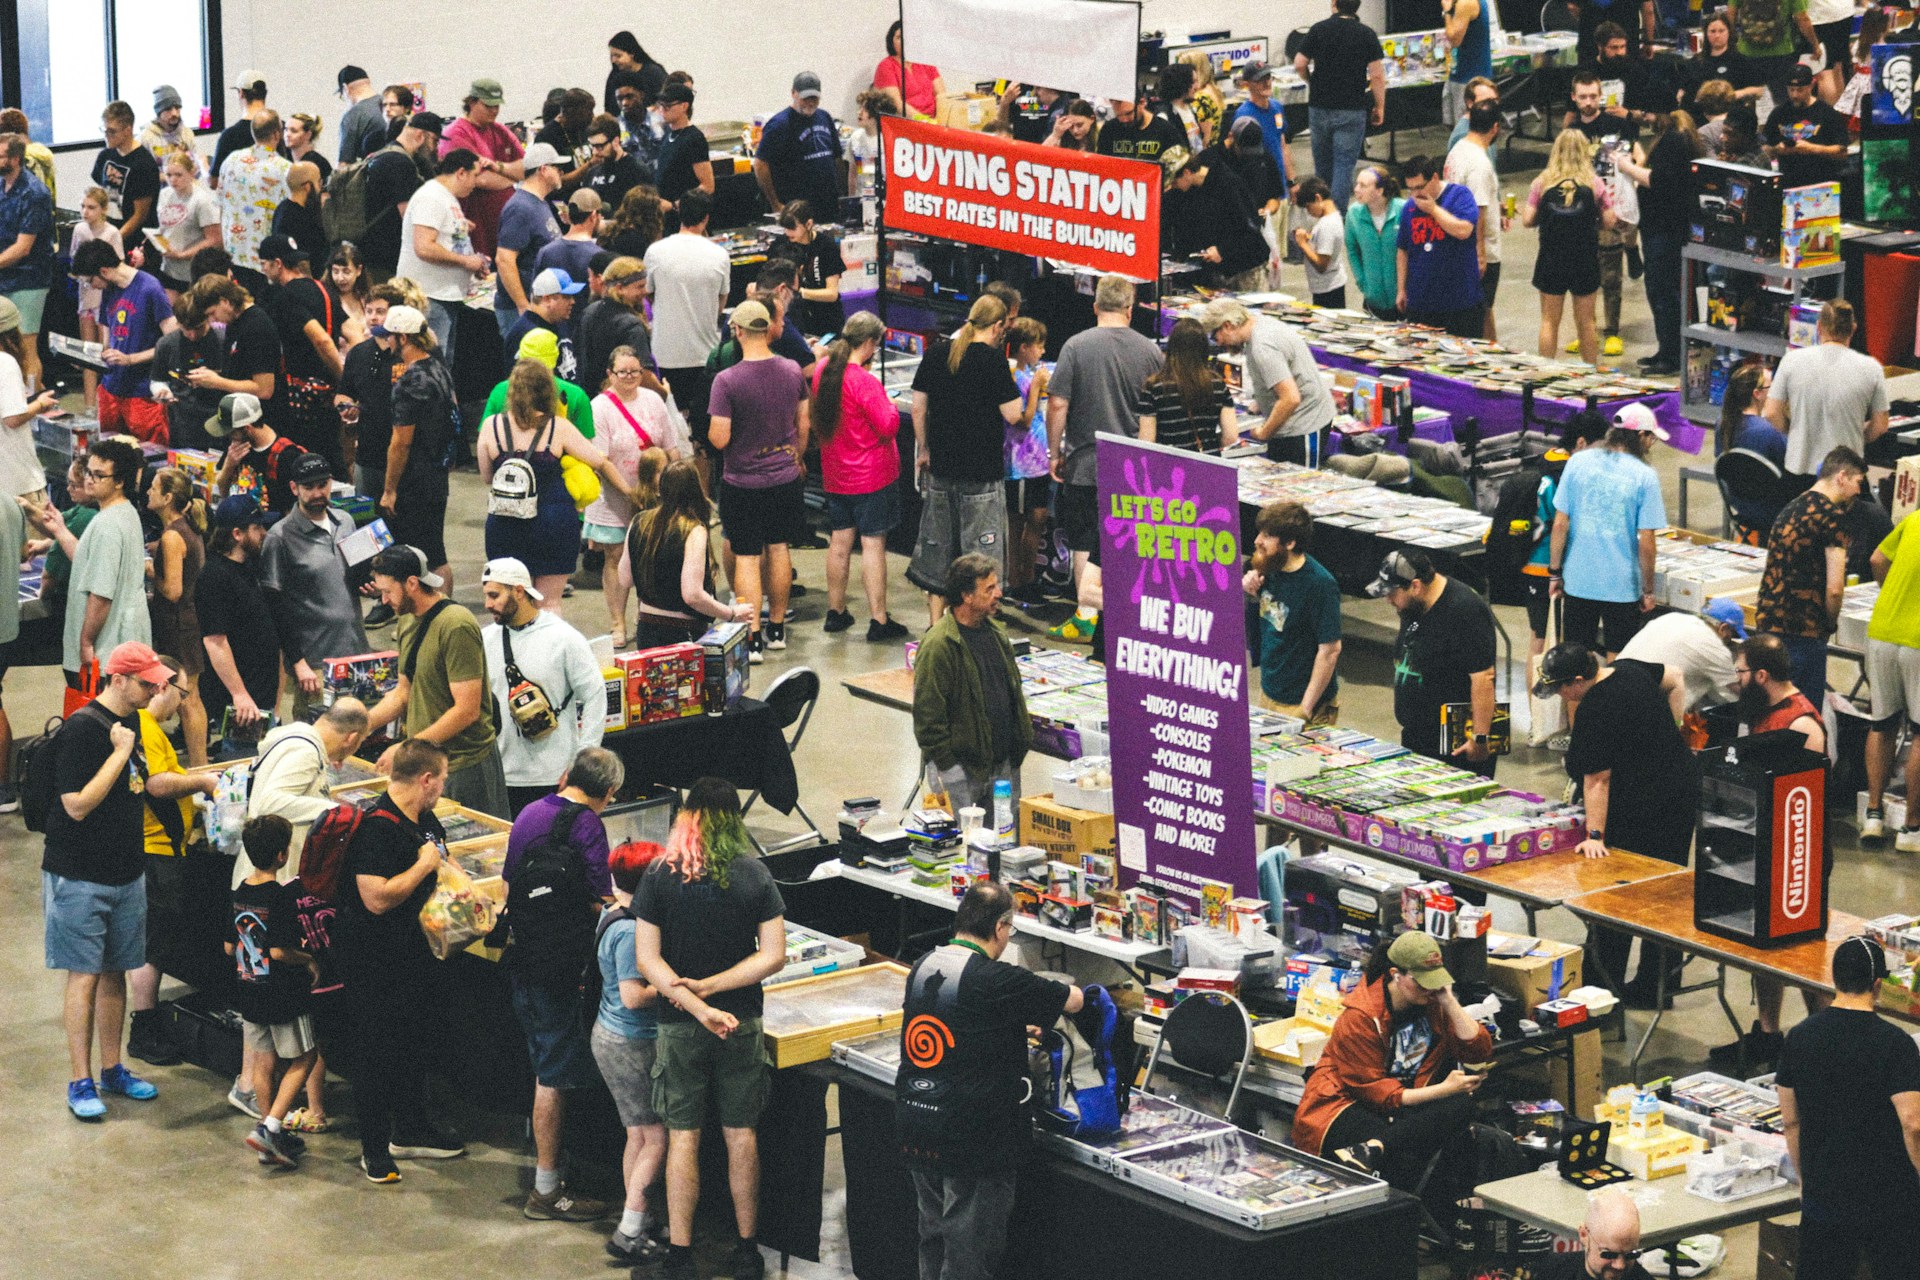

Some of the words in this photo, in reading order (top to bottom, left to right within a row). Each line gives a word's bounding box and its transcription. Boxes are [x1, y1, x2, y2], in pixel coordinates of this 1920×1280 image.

[893, 137, 1011, 197] BUYING
[1014, 159, 1148, 221] STATION
[903, 190, 943, 218] BEST
[945, 198, 996, 229] RATES
[999, 209, 1019, 233] IN
[1021, 213, 1053, 241] THE
[1055, 219, 1136, 257] BUILDING
[1111, 493, 1165, 522] LET'S
[1167, 498, 1197, 525] GO
[1135, 522, 1237, 566] RETRO
[1139, 595, 1171, 634] WE
[1172, 602, 1214, 645] BUY
[1115, 636, 1242, 701] EVERYTHING!
[1179, 703, 1219, 729] GAMES
[1150, 722, 1212, 753] -CONSOLES
[1152, 748, 1212, 778] -POKEMON
[1143, 770, 1193, 799] -VINTAGE
[1195, 782, 1224, 807] TOYS
[1032, 810, 1055, 829] SMALL
[1056, 817, 1072, 833] BOX
[1143, 796, 1185, 822] -COMIC
[1186, 805, 1226, 833] BOOKS
[1154, 822, 1178, 845] AND
[1178, 829, 1217, 856] MORE!
[1789, 798, 1805, 907] Nintendo
